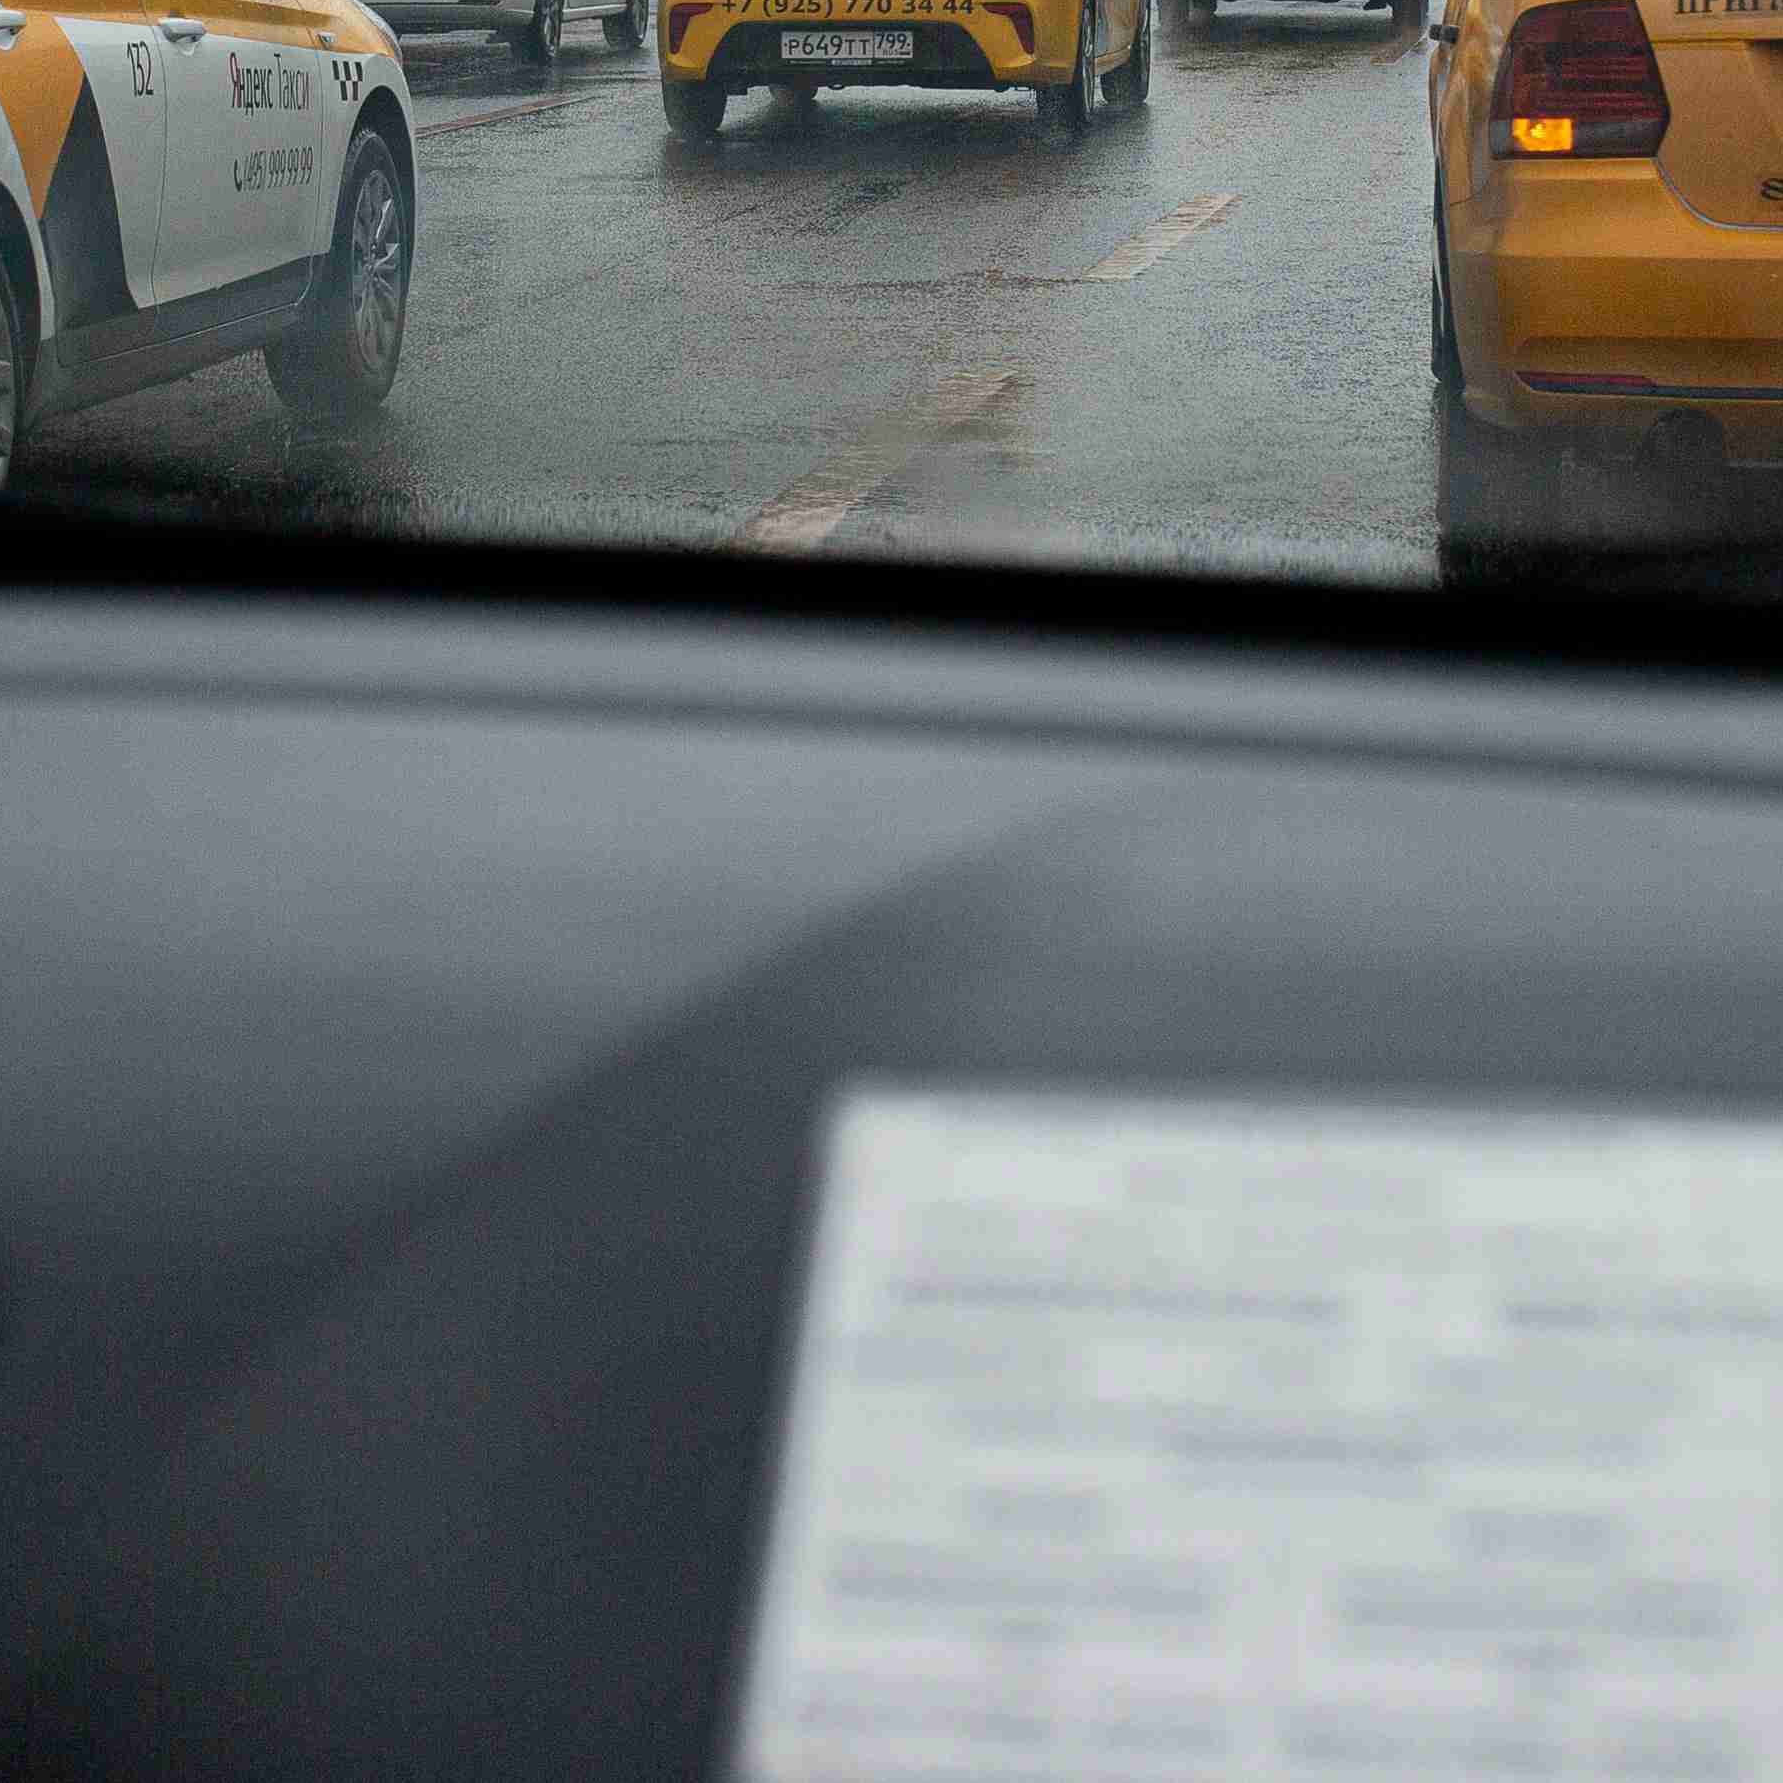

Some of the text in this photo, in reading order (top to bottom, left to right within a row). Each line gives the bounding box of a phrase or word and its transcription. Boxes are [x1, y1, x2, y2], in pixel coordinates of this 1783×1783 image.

[127, 41, 154, 97] 132
[788, 33, 908, 56] Р649ТТ 799
[230, 52, 311, 117] Яндекс Такси
